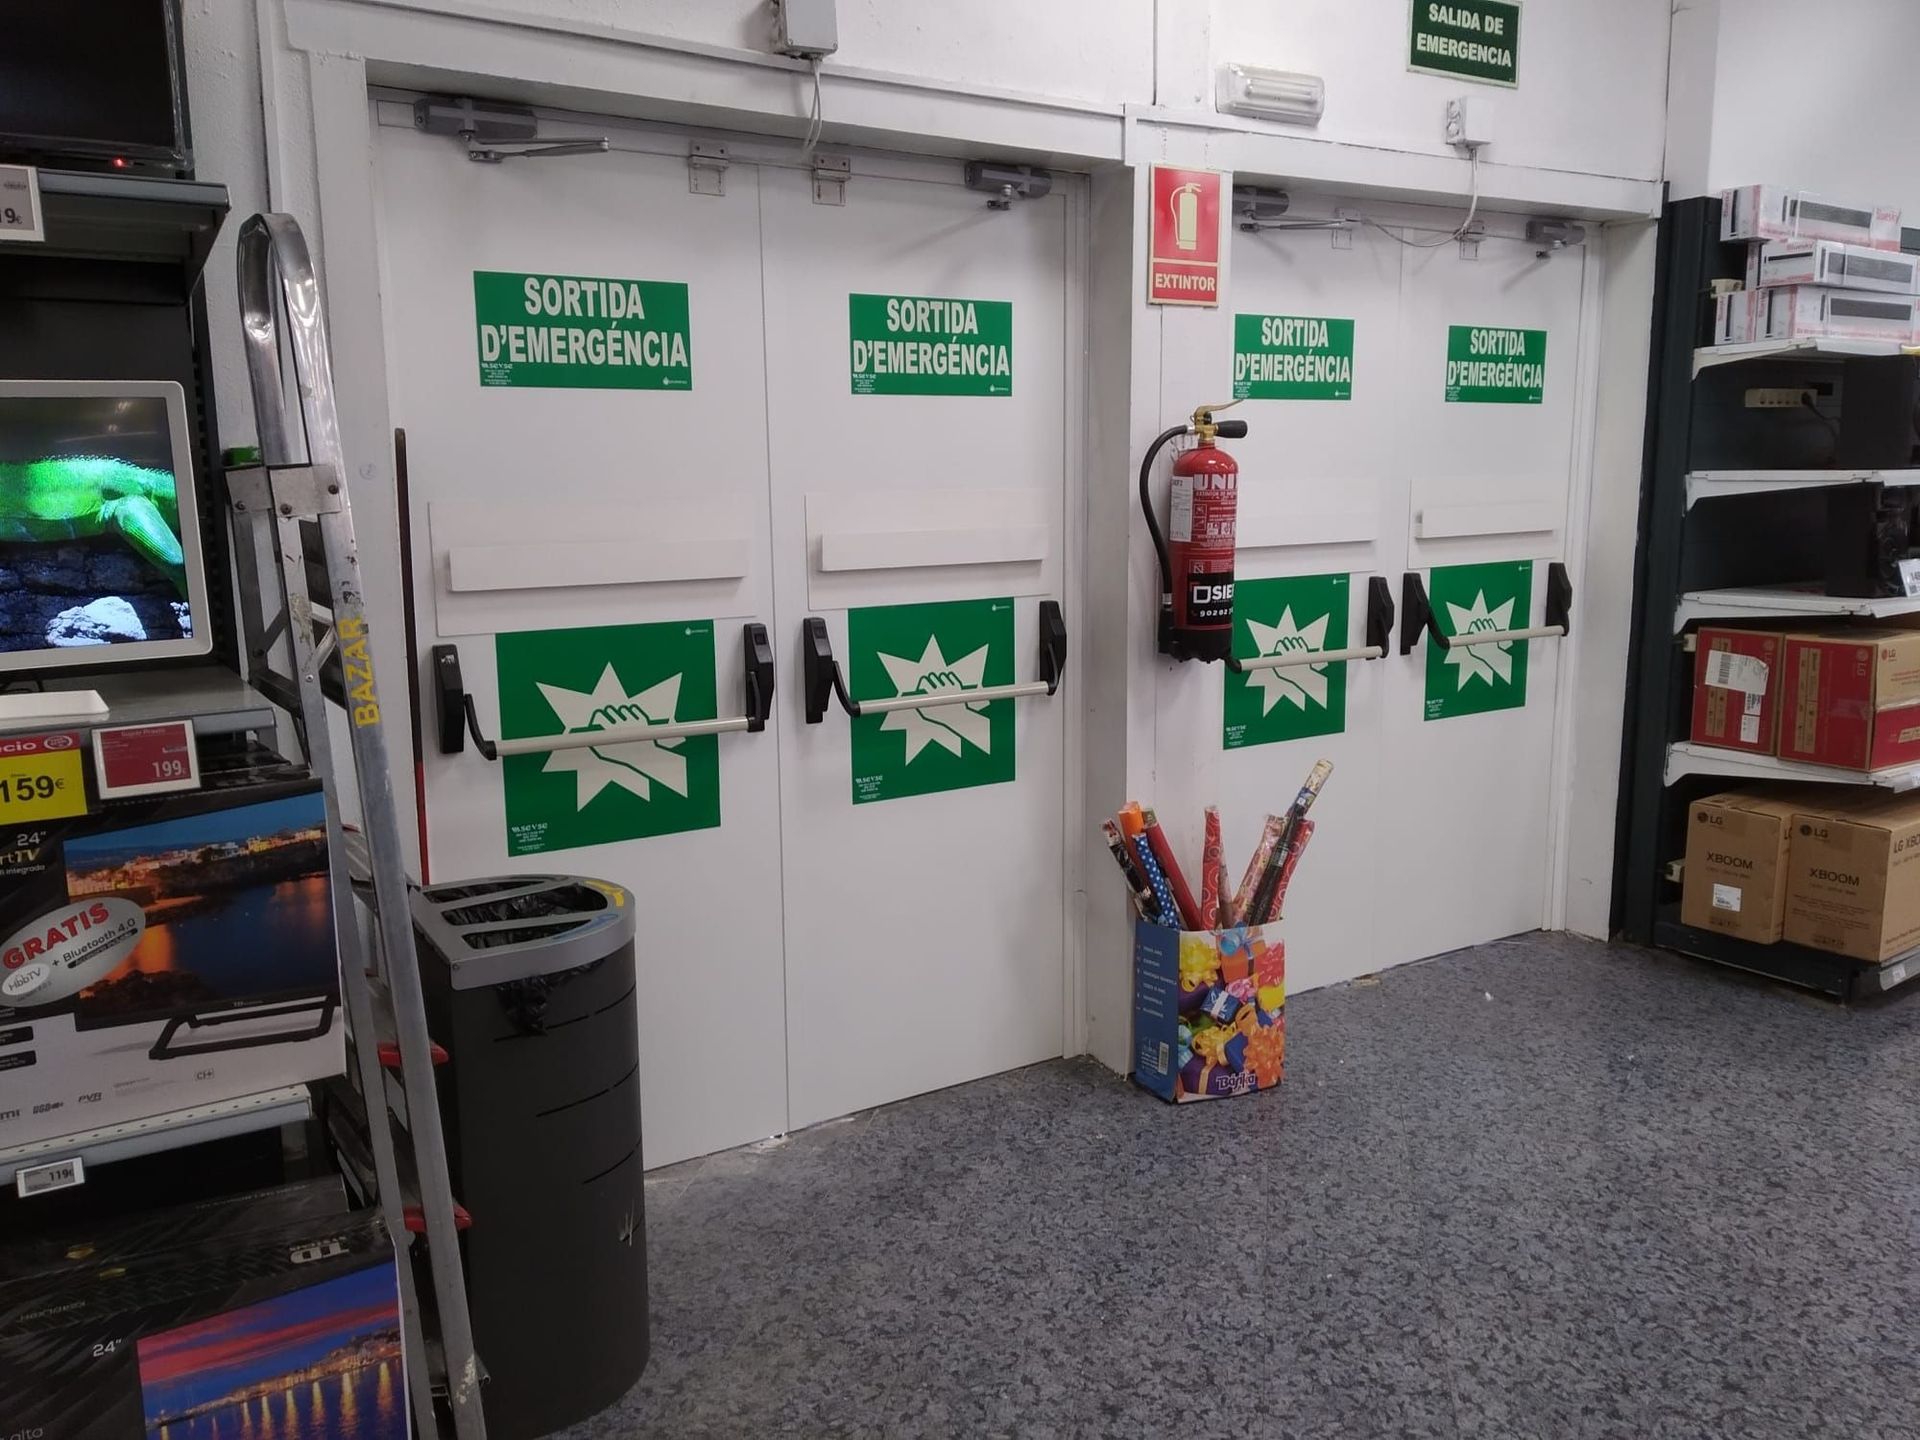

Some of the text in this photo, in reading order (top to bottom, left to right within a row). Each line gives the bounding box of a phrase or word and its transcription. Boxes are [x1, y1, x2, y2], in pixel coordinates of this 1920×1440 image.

[1429, 3, 1504, 36] SALIDA DE
[1416, 32, 1512, 67] EMERGENCIA
[1155, 273, 1216, 291] EXTINTOR
[524, 277, 645, 319] SORTIDA
[887, 298, 978, 334] SORTIDA
[1261, 317, 1329, 347] SORTIDA
[1470, 328, 1525, 356] SORTIDA
[1709, 815, 1723, 826] LG
[1814, 828, 1828, 838] LG
[1706, 851, 1753, 870] XBOOM
[1809, 868, 1860, 887] XBOOM
[3, 902, 110, 970] GRATIS
[62, 929, 116, 963] Bluetooth
[118, 917, 137, 934] 4.0
[8, 967, 42, 992] HbbTV
